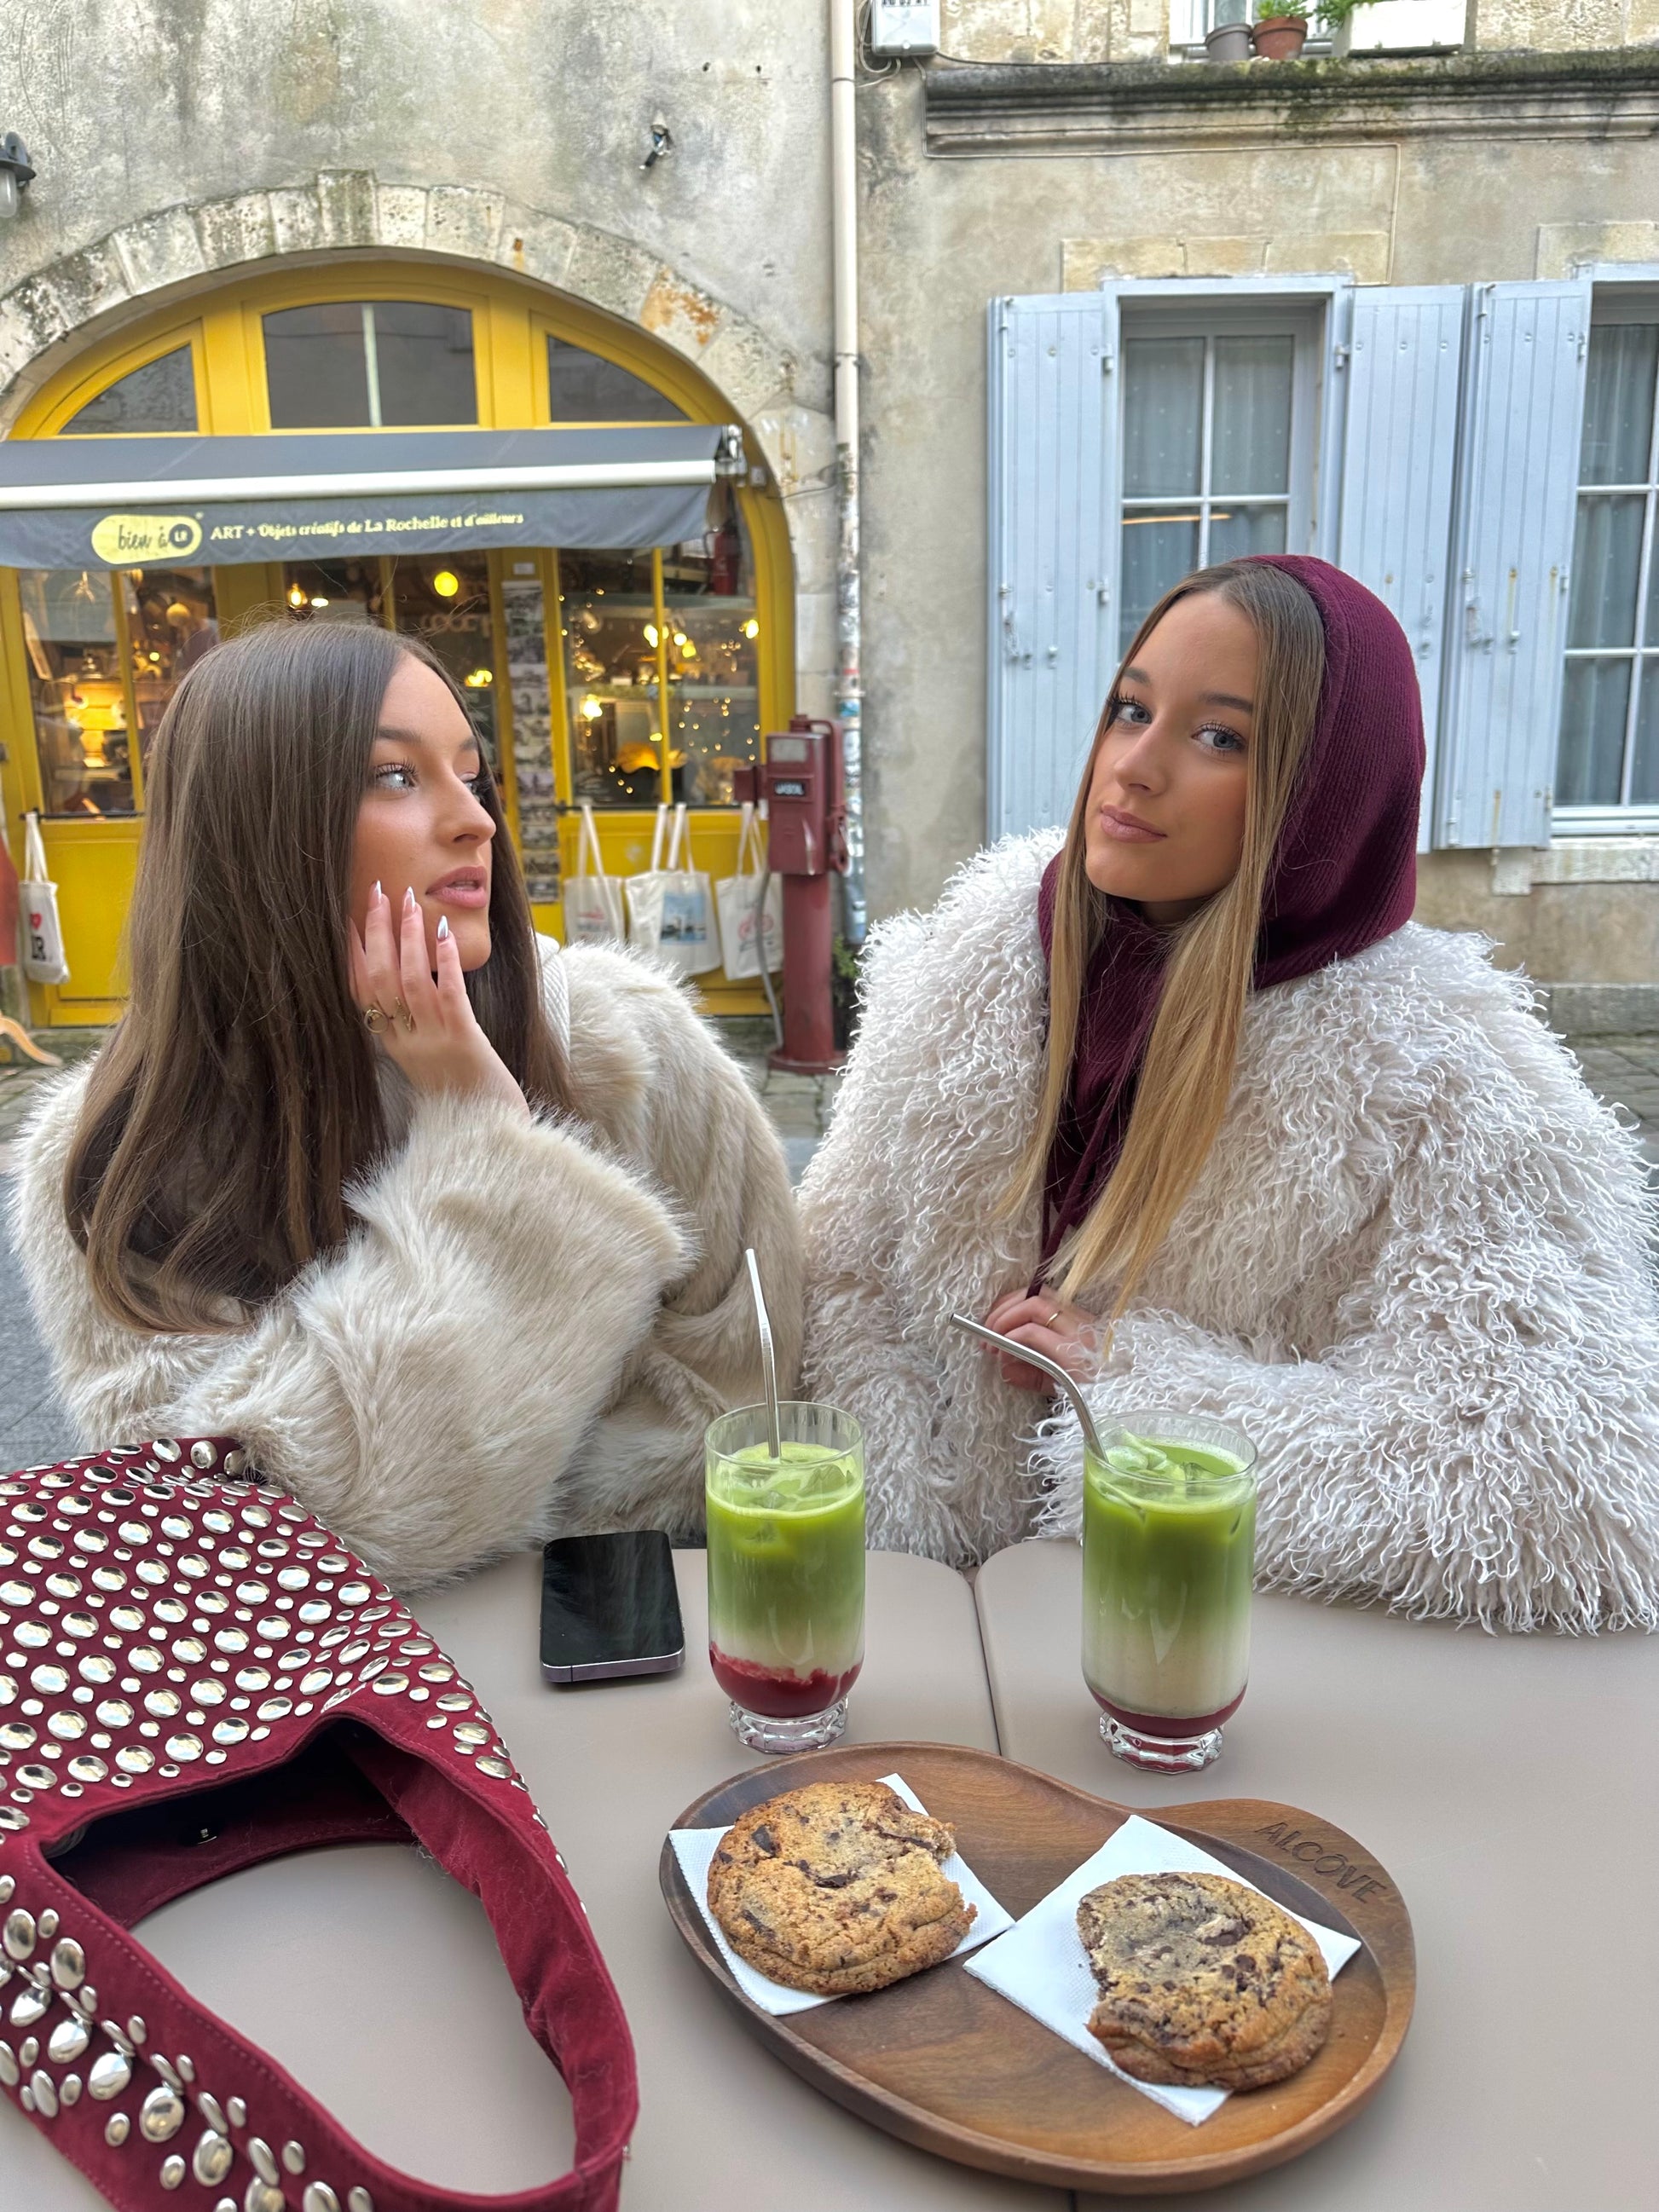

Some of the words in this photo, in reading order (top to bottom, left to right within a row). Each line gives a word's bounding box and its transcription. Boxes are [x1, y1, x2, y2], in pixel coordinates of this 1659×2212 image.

[118, 524, 153, 551] bien
[210, 525, 245, 540] ART
[257, 523, 298, 540] Objets
[346, 521, 363, 534] de
[365, 519, 383, 533] La
[385, 515, 448, 532] Rochelle
[450, 516, 462, 528] et
[465, 512, 524, 528] d'ailleurs
[1254, 1822, 1387, 1903] ALCOVE
